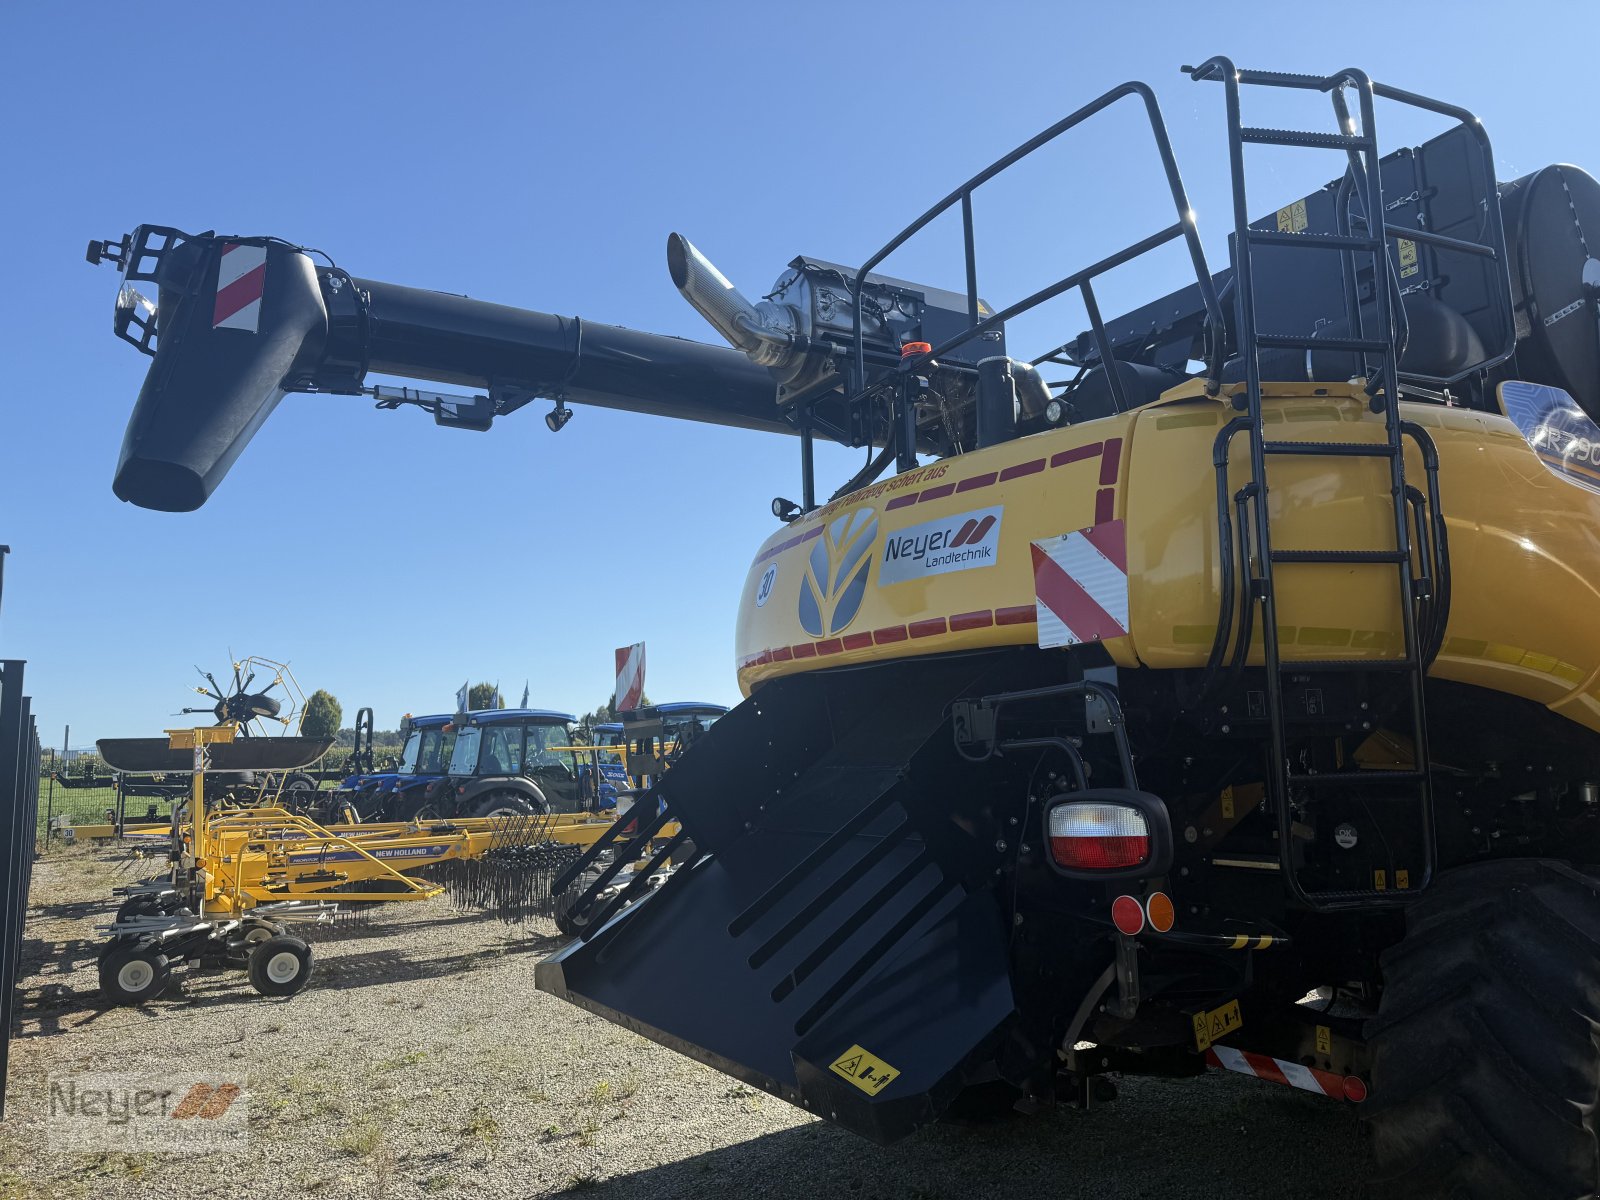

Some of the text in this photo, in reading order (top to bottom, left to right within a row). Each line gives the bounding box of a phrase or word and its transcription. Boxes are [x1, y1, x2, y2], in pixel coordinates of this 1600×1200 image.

[886, 469, 926, 492] schert
[923, 464, 949, 482] aus
[885, 529, 952, 561] Neyer
[925, 545, 992, 568] Landtechnik
[758, 569, 775, 600] 30
[64, 829, 73, 837] 30
[375, 848, 427, 858] NEW HOLLAND
